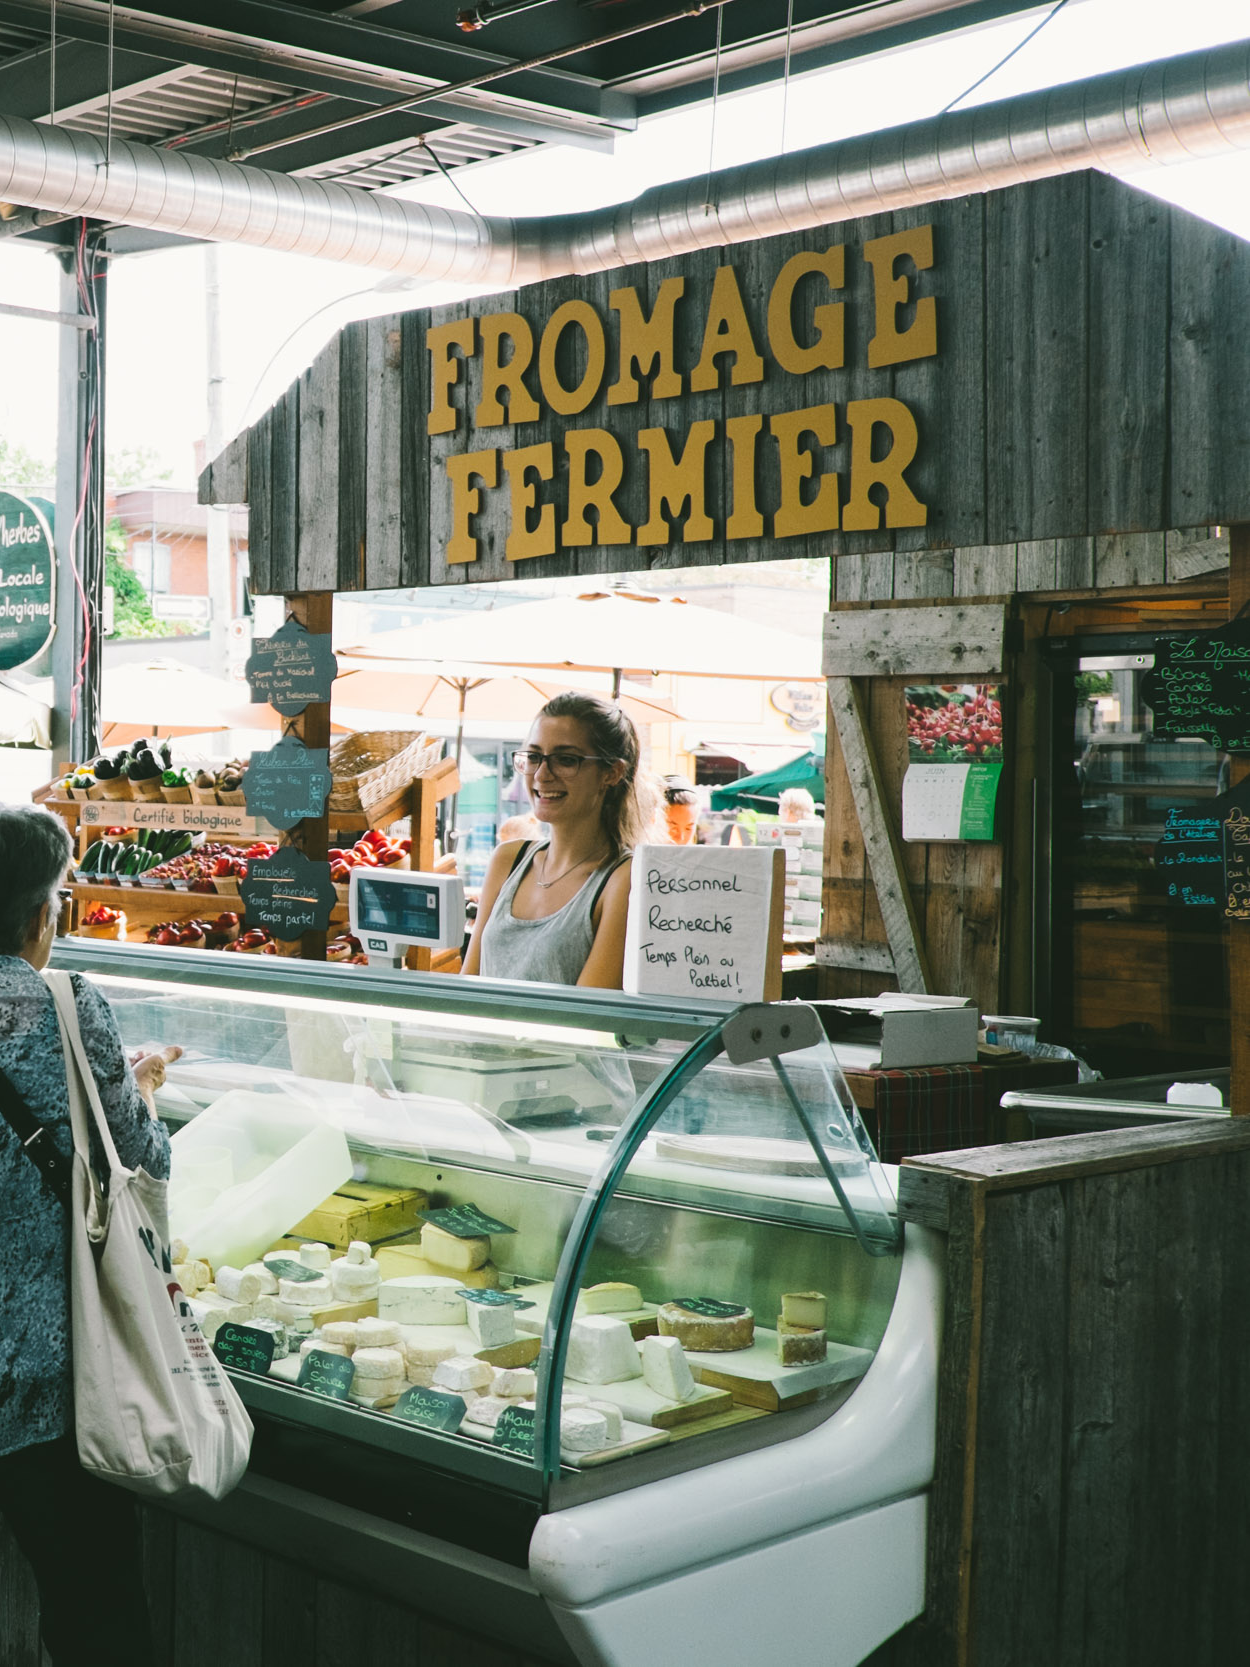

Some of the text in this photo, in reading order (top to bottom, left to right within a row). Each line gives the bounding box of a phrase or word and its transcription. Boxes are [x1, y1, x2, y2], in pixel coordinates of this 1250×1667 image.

[426, 224, 937, 436] FROMAGE
[447, 397, 927, 565] FERMIER
[1169, 639, 1196, 659] La
[133, 807, 243, 829] Certifié biologique
[646, 869, 743, 894] Personnel
[248, 893, 269, 908] Temps
[258, 910, 315, 928] Temps partiel
[648, 905, 733, 934] Recherché
[639, 942, 734, 968] Temps Plein ou
[225, 1328, 258, 1346] Cendré
[308, 1355, 335, 1370] Palet
[409, 1392, 450, 1408] Maison
[403, 1404, 435, 1420] Grise
